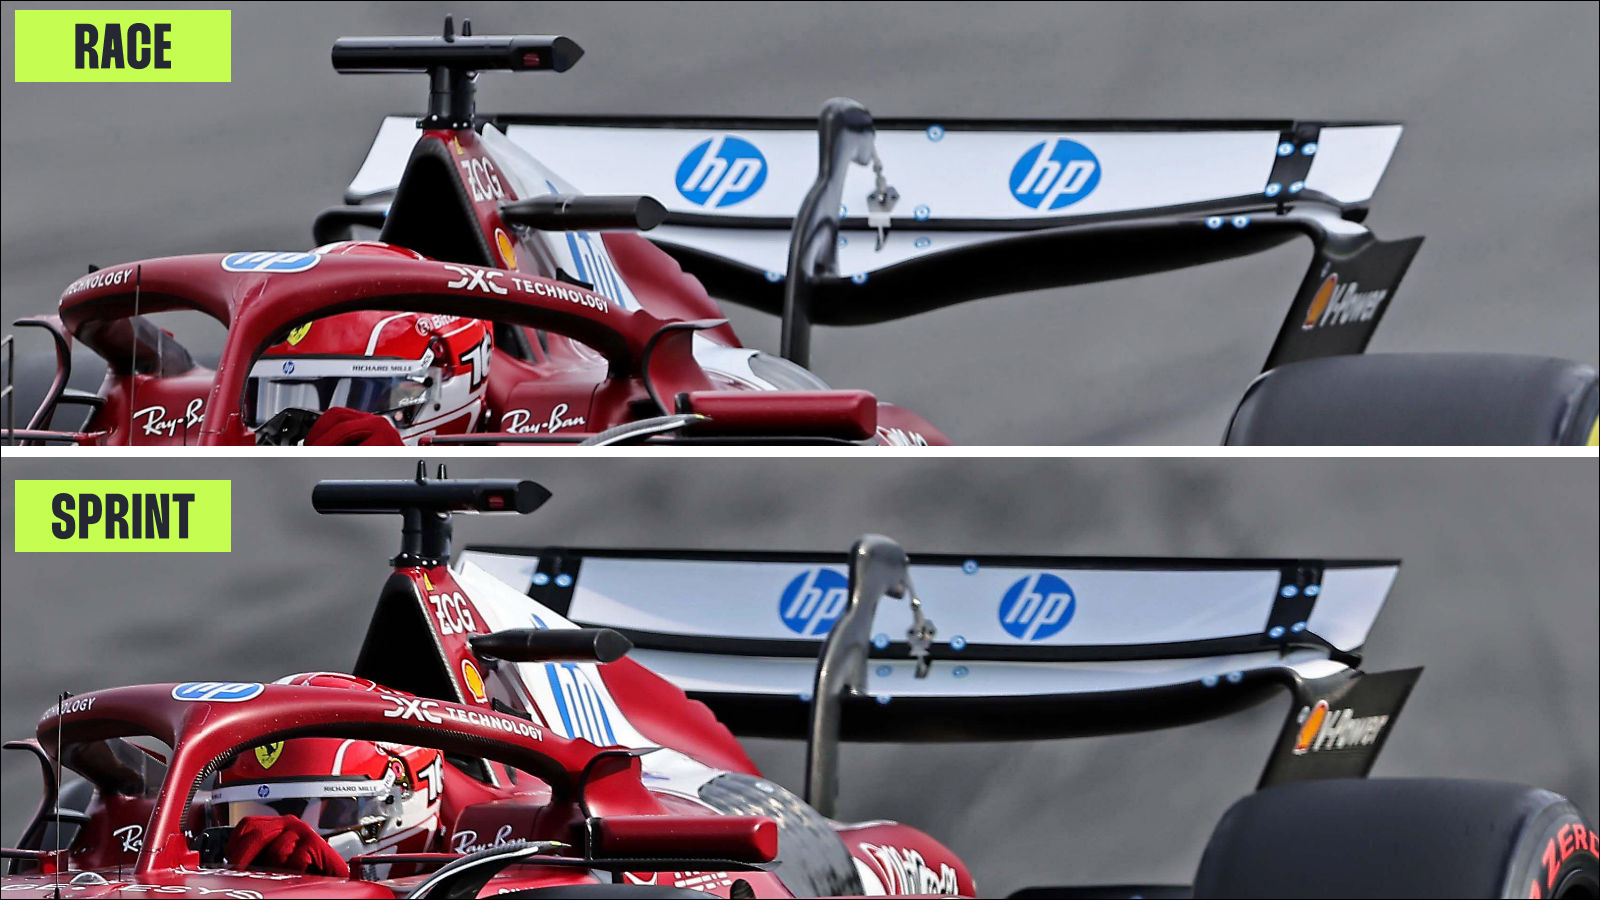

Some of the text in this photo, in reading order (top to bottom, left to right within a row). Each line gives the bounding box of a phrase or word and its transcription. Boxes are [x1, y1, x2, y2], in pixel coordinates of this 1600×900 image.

[461, 156, 505, 202] ZCG
[680, 135, 765, 207] hp
[1013, 138, 1098, 210] hp
[444, 264, 610, 314] DXC TECHNOLOGY
[133, 398, 206, 437] Ray-Ba
[502, 403, 586, 434] Ray-Ban
[429, 591, 476, 635] ZCG
[782, 569, 849, 635] hp
[1002, 573, 1074, 640] hp
[381, 695, 544, 742] DXC TECHNOLOGY
